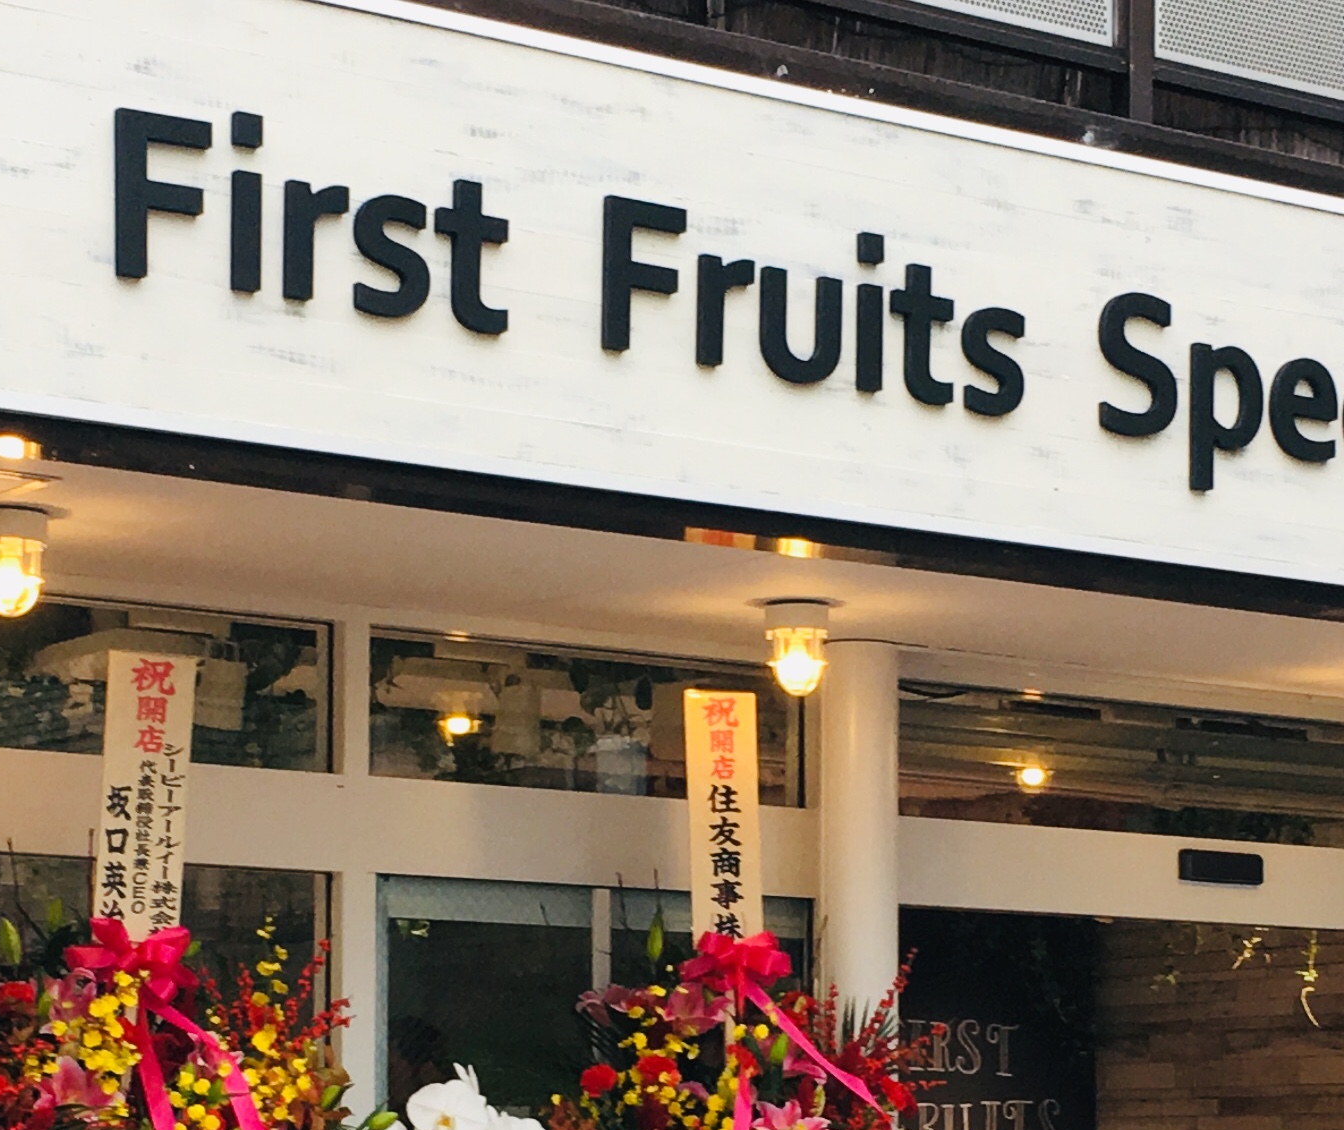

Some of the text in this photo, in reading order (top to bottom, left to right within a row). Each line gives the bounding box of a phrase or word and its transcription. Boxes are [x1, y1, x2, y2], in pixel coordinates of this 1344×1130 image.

[114, 107, 509, 339] First
[600, 194, 1025, 419] Fruits
[130, 657, 176, 753] 祝開店
[703, 697, 739, 780] 祝開店
[903, 1018, 1020, 1077] IRST
